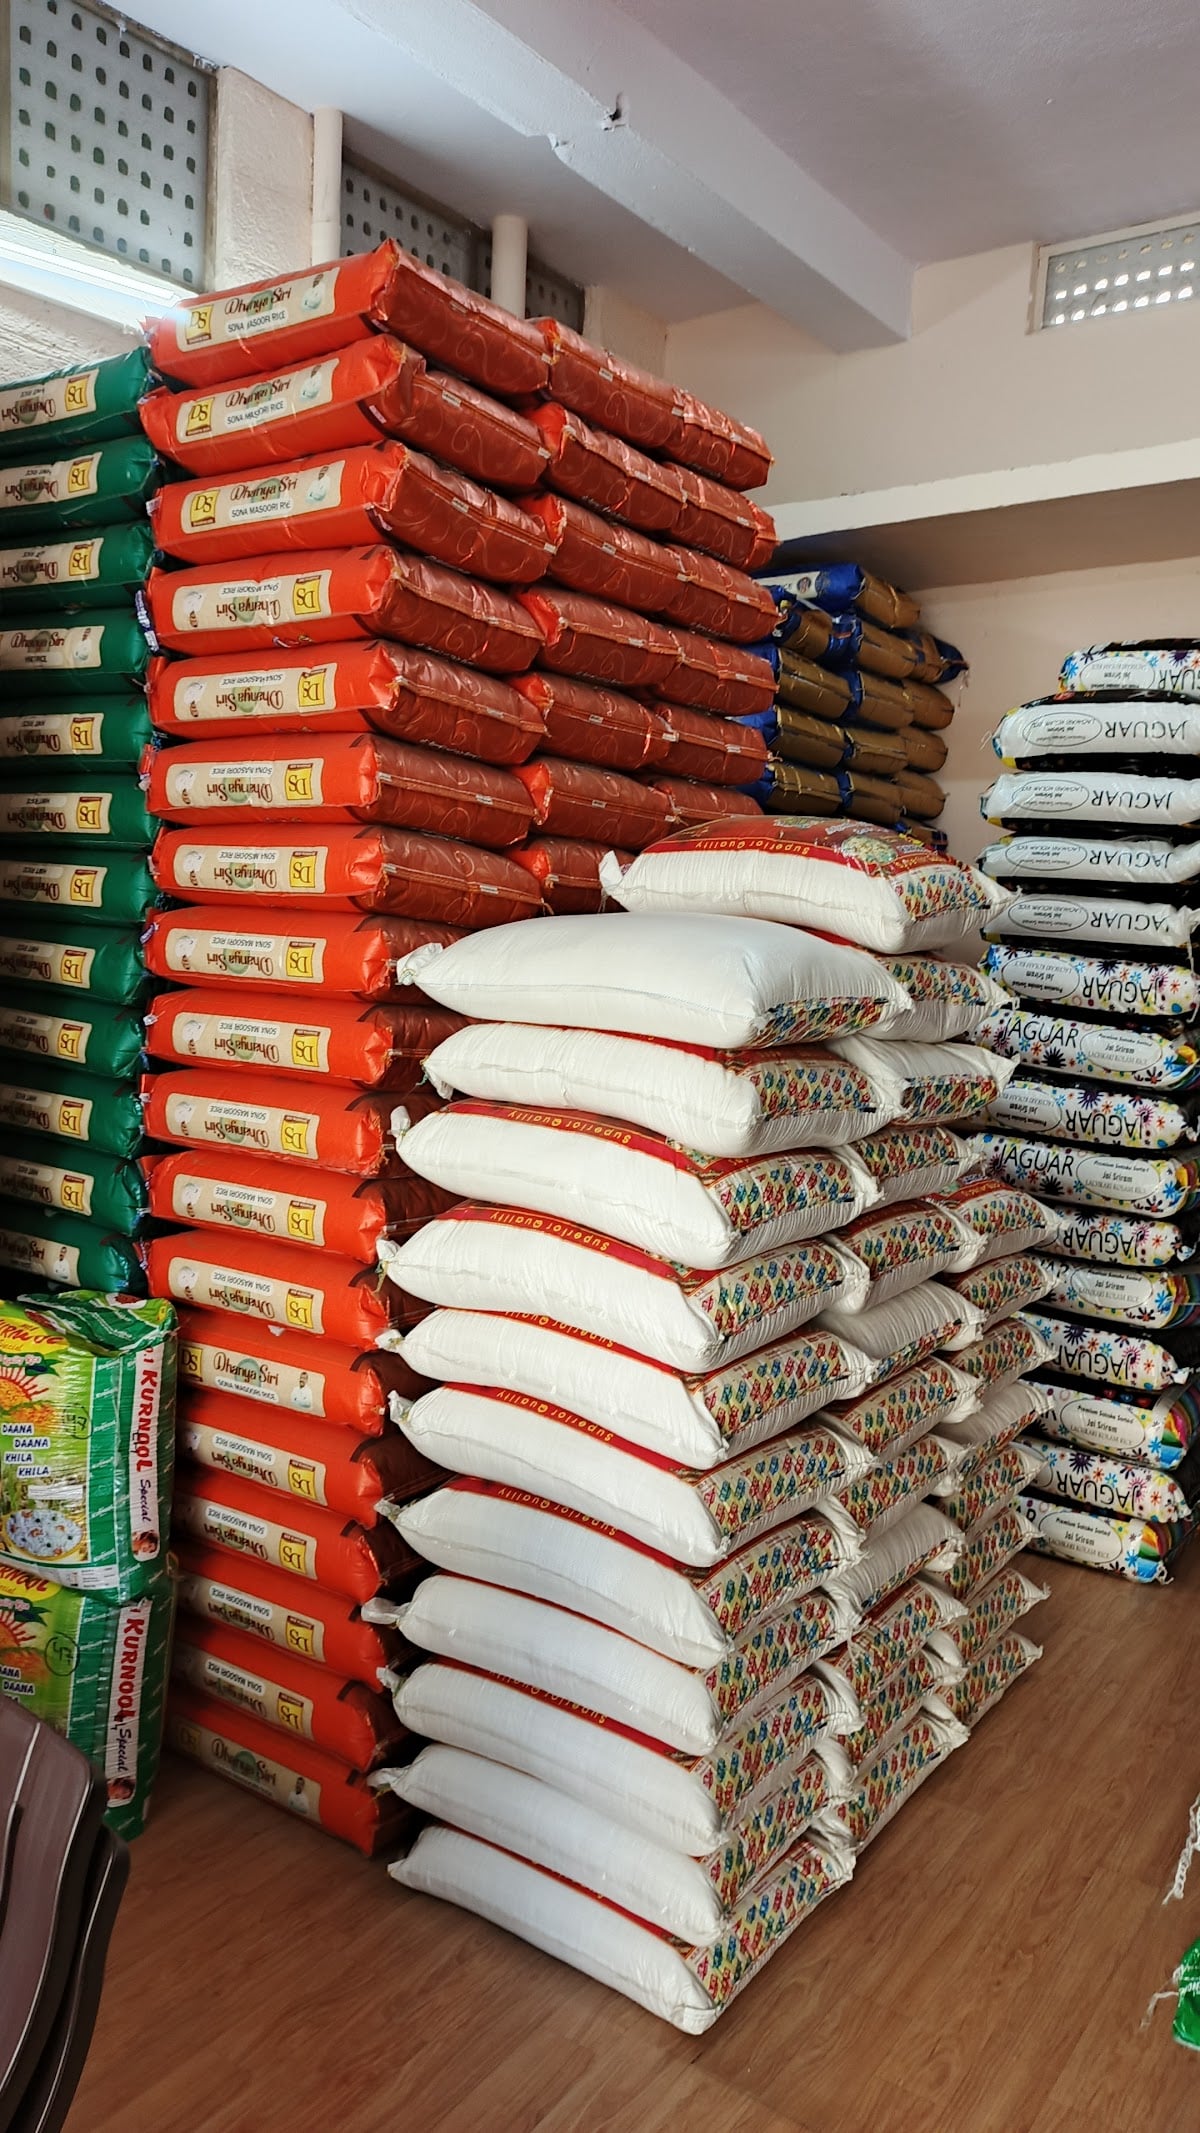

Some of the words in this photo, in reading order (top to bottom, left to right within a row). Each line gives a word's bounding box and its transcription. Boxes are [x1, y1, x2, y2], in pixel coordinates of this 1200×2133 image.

[271, 288, 292, 303] Siri
[190, 310, 207, 329] DS
[67, 385, 83, 405] DS
[270, 378, 292, 395] Siri
[191, 404, 209, 422] DS
[227, 413, 244, 425] SONA
[270, 401, 284, 411] RICE
[71, 468, 86, 486] DS
[231, 484, 276, 500] Dhanya
[279, 476, 298, 493] Siri
[194, 494, 213, 513] DS
[231, 506, 249, 518] SONA
[249, 503, 279, 515] MASOORI
[72, 552, 88, 571] DS
[296, 588, 315, 609] DS
[216, 604, 238, 622] Siri
[238, 687, 284, 710] Dhanya
[303, 680, 319, 701] DS
[216, 694, 237, 712] Siri
[73, 726, 90, 746] DS
[1104, 720, 1188, 740] JAGUAR
[206, 783, 228, 801] Siri
[228, 778, 273, 804] Dhanya
[288, 774, 307, 796] DS
[1091, 790, 1174, 810] JAGUAR
[79, 805, 97, 826] DS
[696, 840, 747, 849] Quality
[749, 840, 810, 855] Superior
[219, 851, 234, 860] RICE
[1089, 850, 1174, 869] JAGUAR
[213, 868, 234, 886] Siri
[234, 863, 278, 889] Dhanya
[292, 861, 312, 884] DS
[73, 878, 91, 898] DS
[63, 959, 80, 980] DS
[206, 952, 228, 971] Siri
[228, 950, 274, 977] Dhanya
[289, 951, 308, 974] DS
[1082, 976, 1160, 1005] JAGUAR
[60, 1033, 76, 1054] DS
[1002, 1017, 1080, 1049] JAGUAR
[213, 1037, 236, 1057] Siri
[235, 1037, 280, 1064] Dhanya
[295, 1040, 314, 1063] DS
[61, 1110, 77, 1131] DS
[507, 1110, 562, 1127] Quality
[1066, 1109, 1146, 1140] JAGUAR
[204, 1120, 226, 1140] Siri
[224, 1118, 270, 1148] Dhanya
[284, 1126, 303, 1150] DS
[565, 1120, 632, 1144] Superior
[999, 1144, 1074, 1177] JAGUAR
[1102, 1171, 1113, 1180] Jai
[1112, 1172, 1133, 1183] Sriram
[63, 1185, 80, 1207] DS
[210, 1202, 233, 1222] Siri
[231, 1203, 276, 1233] Dhanya
[490, 1211, 543, 1229] Quality
[291, 1212, 310, 1236] DS
[546, 1222, 610, 1251] Superior
[1063, 1227, 1145, 1258] JAGUAR
[1105, 1281, 1125, 1291] Sriram
[208, 1287, 231, 1308] Siri
[229, 1290, 275, 1319] Dhanya
[289, 1300, 308, 1324] DS
[181, 1349, 198, 1372] DS
[213, 1351, 257, 1383] Dhanya
[258, 1363, 279, 1387] Siri
[496, 1389, 549, 1413] Quality
[2, 1424, 33, 1434] DAANA
[136, 1369, 158, 1473] KURNOOL
[550, 1408, 614, 1442] Superior
[1087, 1419, 1098, 1429] Jai
[1097, 1420, 1118, 1433] Sriram
[14, 1438, 49, 1449] DAANA
[5, 1452, 33, 1463] KHILA
[18, 1466, 49, 1477] KHILA
[292, 1472, 312, 1495] DS
[1056, 1470, 1140, 1512] JAGUAR
[139, 1479, 152, 1522] Special
[498, 1486, 551, 1509] Quality
[1064, 1531, 1075, 1541] Jai
[1075, 1533, 1096, 1546] Sriram
[283, 1545, 301, 1570] DS
[225, 1592, 253, 1611] MASOORI
[252, 1604, 270, 1617] SONA
[289, 1628, 310, 1653] DS
[115, 1617, 145, 1721] KURNOOL
[3, 1681, 34, 1694] DAANA
[246, 1679, 263, 1694] SONA
[281, 1705, 300, 1730] DS
[116, 1729, 132, 1772] Special
[256, 1760, 277, 1787] Siri
